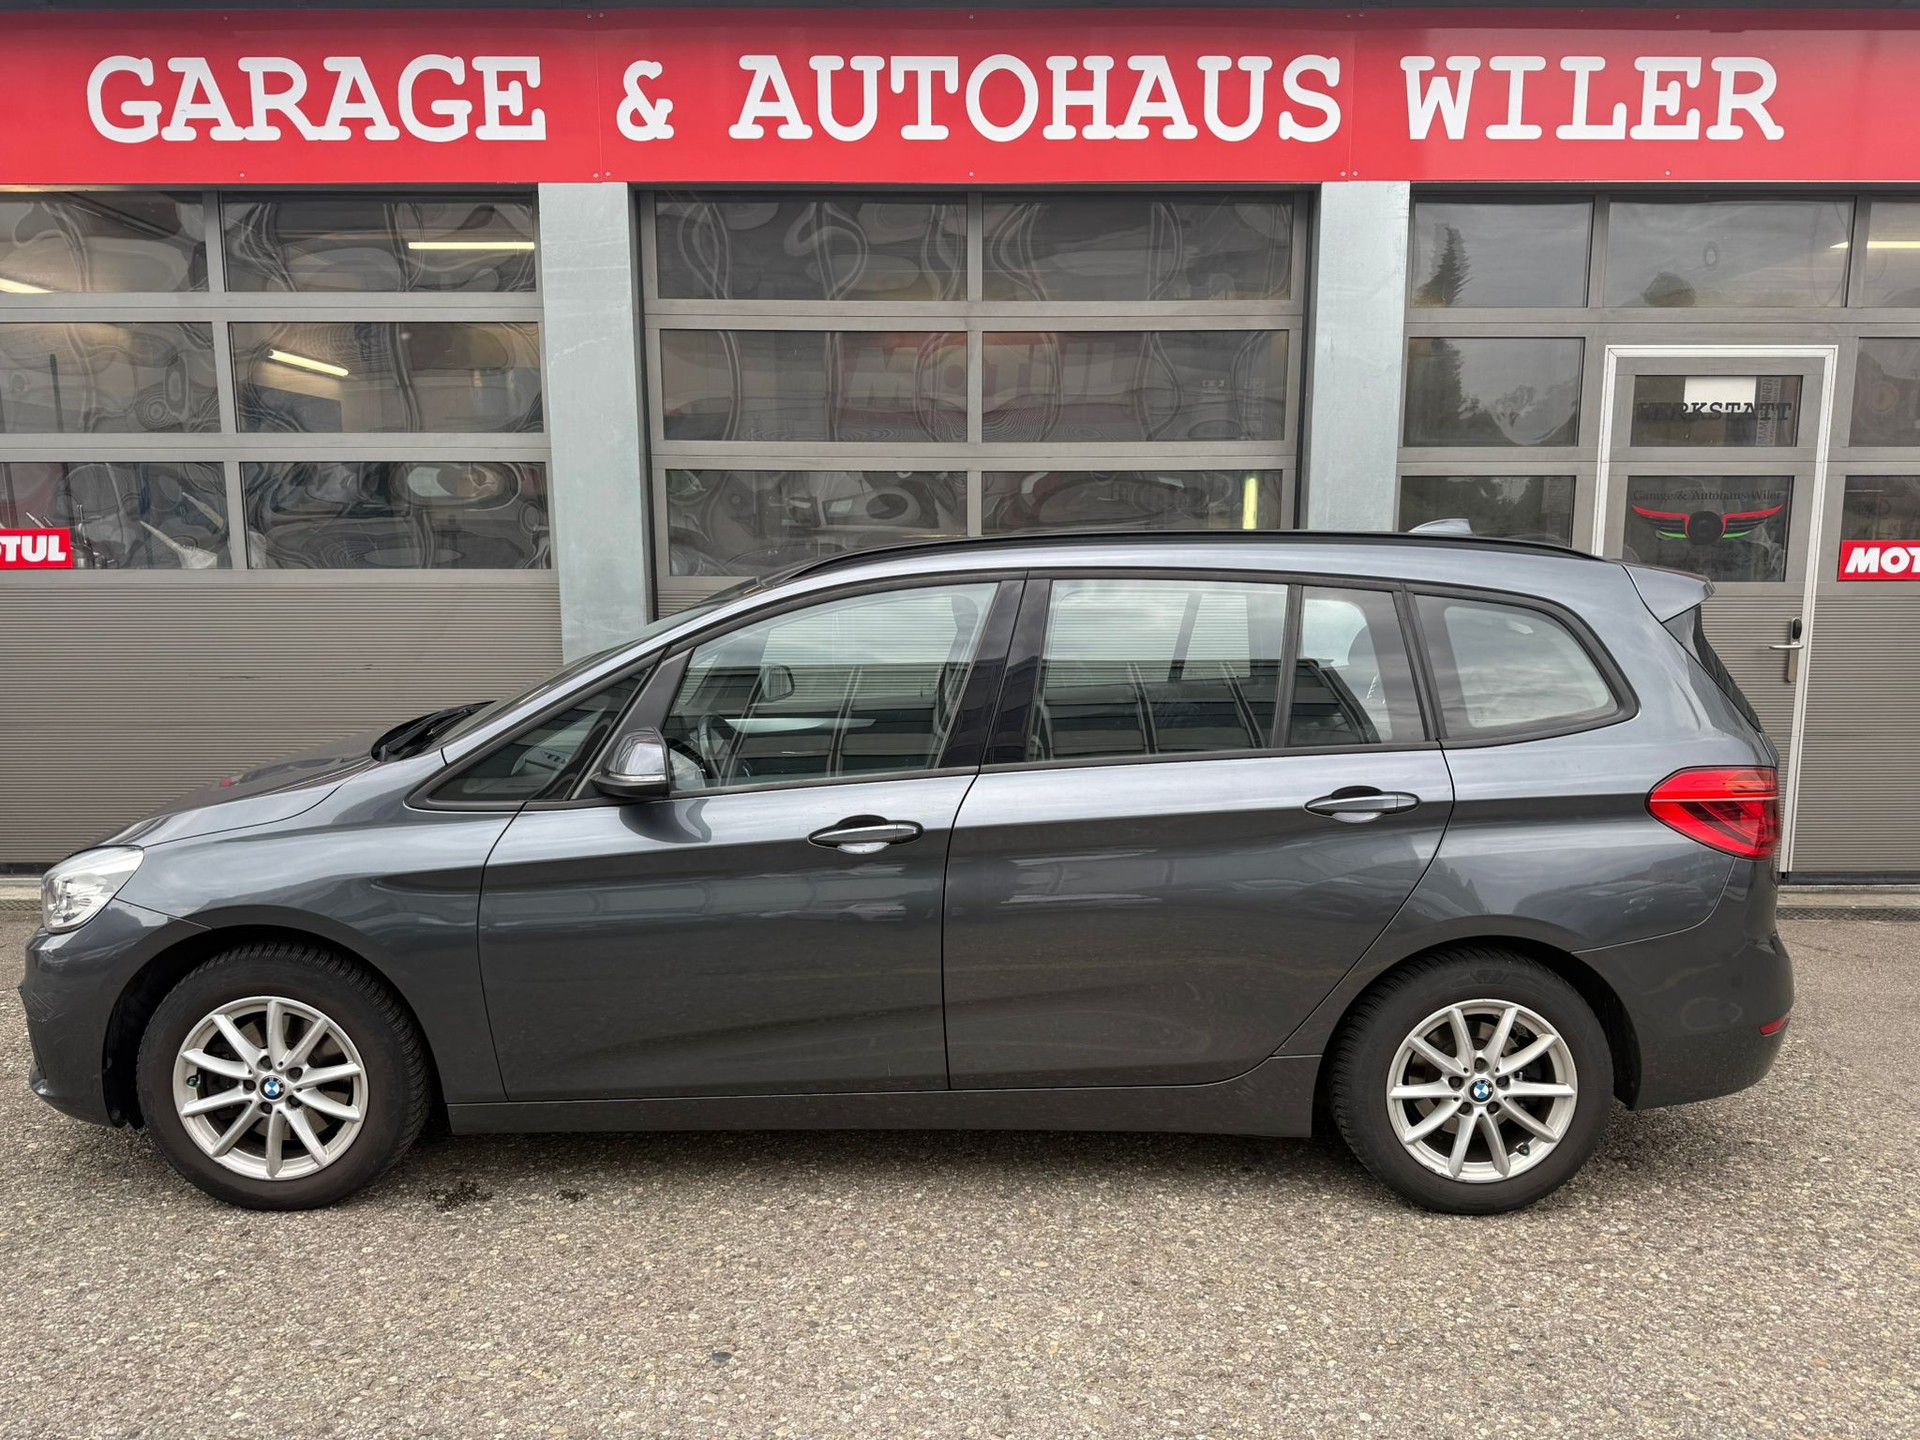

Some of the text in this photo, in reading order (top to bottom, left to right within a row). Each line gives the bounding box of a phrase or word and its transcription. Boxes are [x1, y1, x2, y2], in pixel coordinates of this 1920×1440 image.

[87, 54, 1784, 143] GARAGE & AUTOHAUS WILER
[1632, 490, 1781, 501] Garage & Autohaus Wiler
[0, 535, 67, 562] TUL
